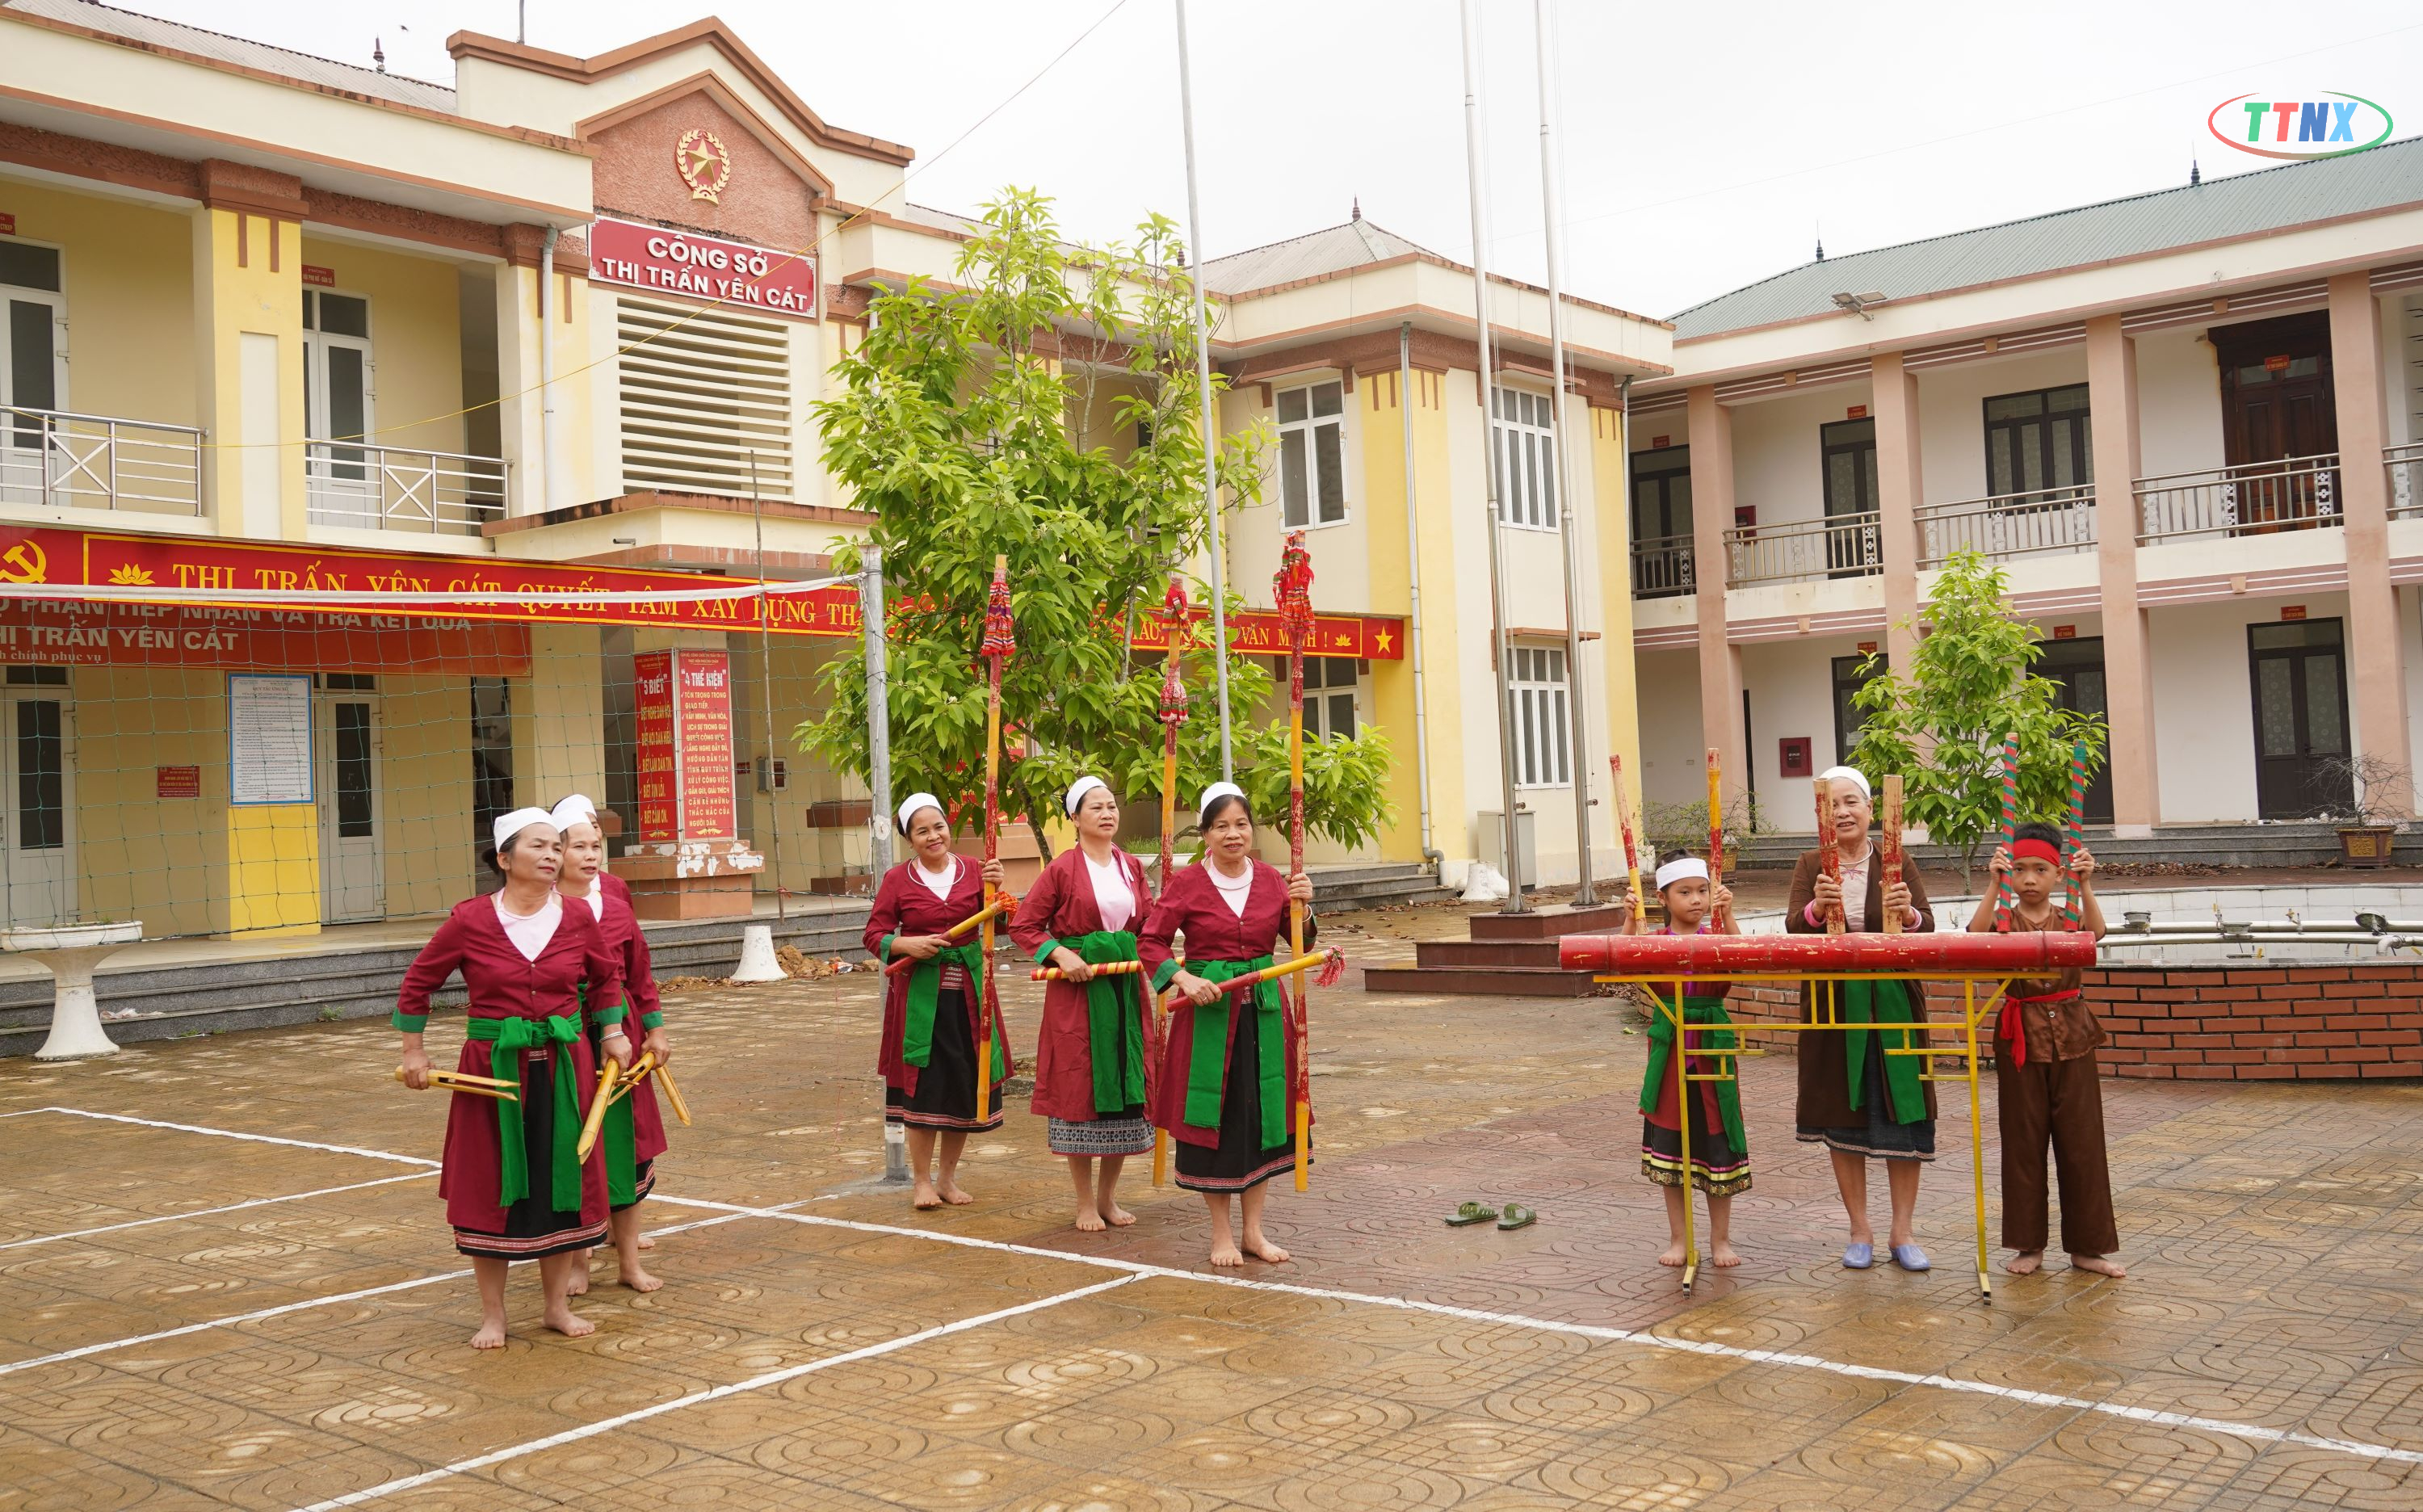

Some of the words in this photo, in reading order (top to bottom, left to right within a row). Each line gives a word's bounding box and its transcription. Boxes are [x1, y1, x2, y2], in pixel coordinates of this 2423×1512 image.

[647, 234, 729, 269] CÔNG
[733, 250, 768, 277] SỞ
[602, 257, 639, 284] THỊ
[646, 265, 708, 294] TRẤN
[716, 277, 759, 302] YÊN
[766, 286, 807, 311] CÁT
[255, 560, 348, 591] TRẤN
[366, 569, 431, 592] YÊN
[448, 572, 501, 607] CÁT
[517, 575, 610, 614] QUYẾT
[753, 595, 816, 628] DỰNG
[27, 620, 109, 647] TRẤN
[118, 626, 174, 648] YÊN
[183, 628, 238, 650] CÁT
[1241, 622, 1270, 645] VĂN
[1278, 629, 1316, 647] MH
[11, 650, 47, 661] chính
[51, 651, 83, 663] phục
[86, 654, 101, 663] vụ
[691, 667, 705, 686] THỂ
[695, 692, 710, 700] TRỌNG
